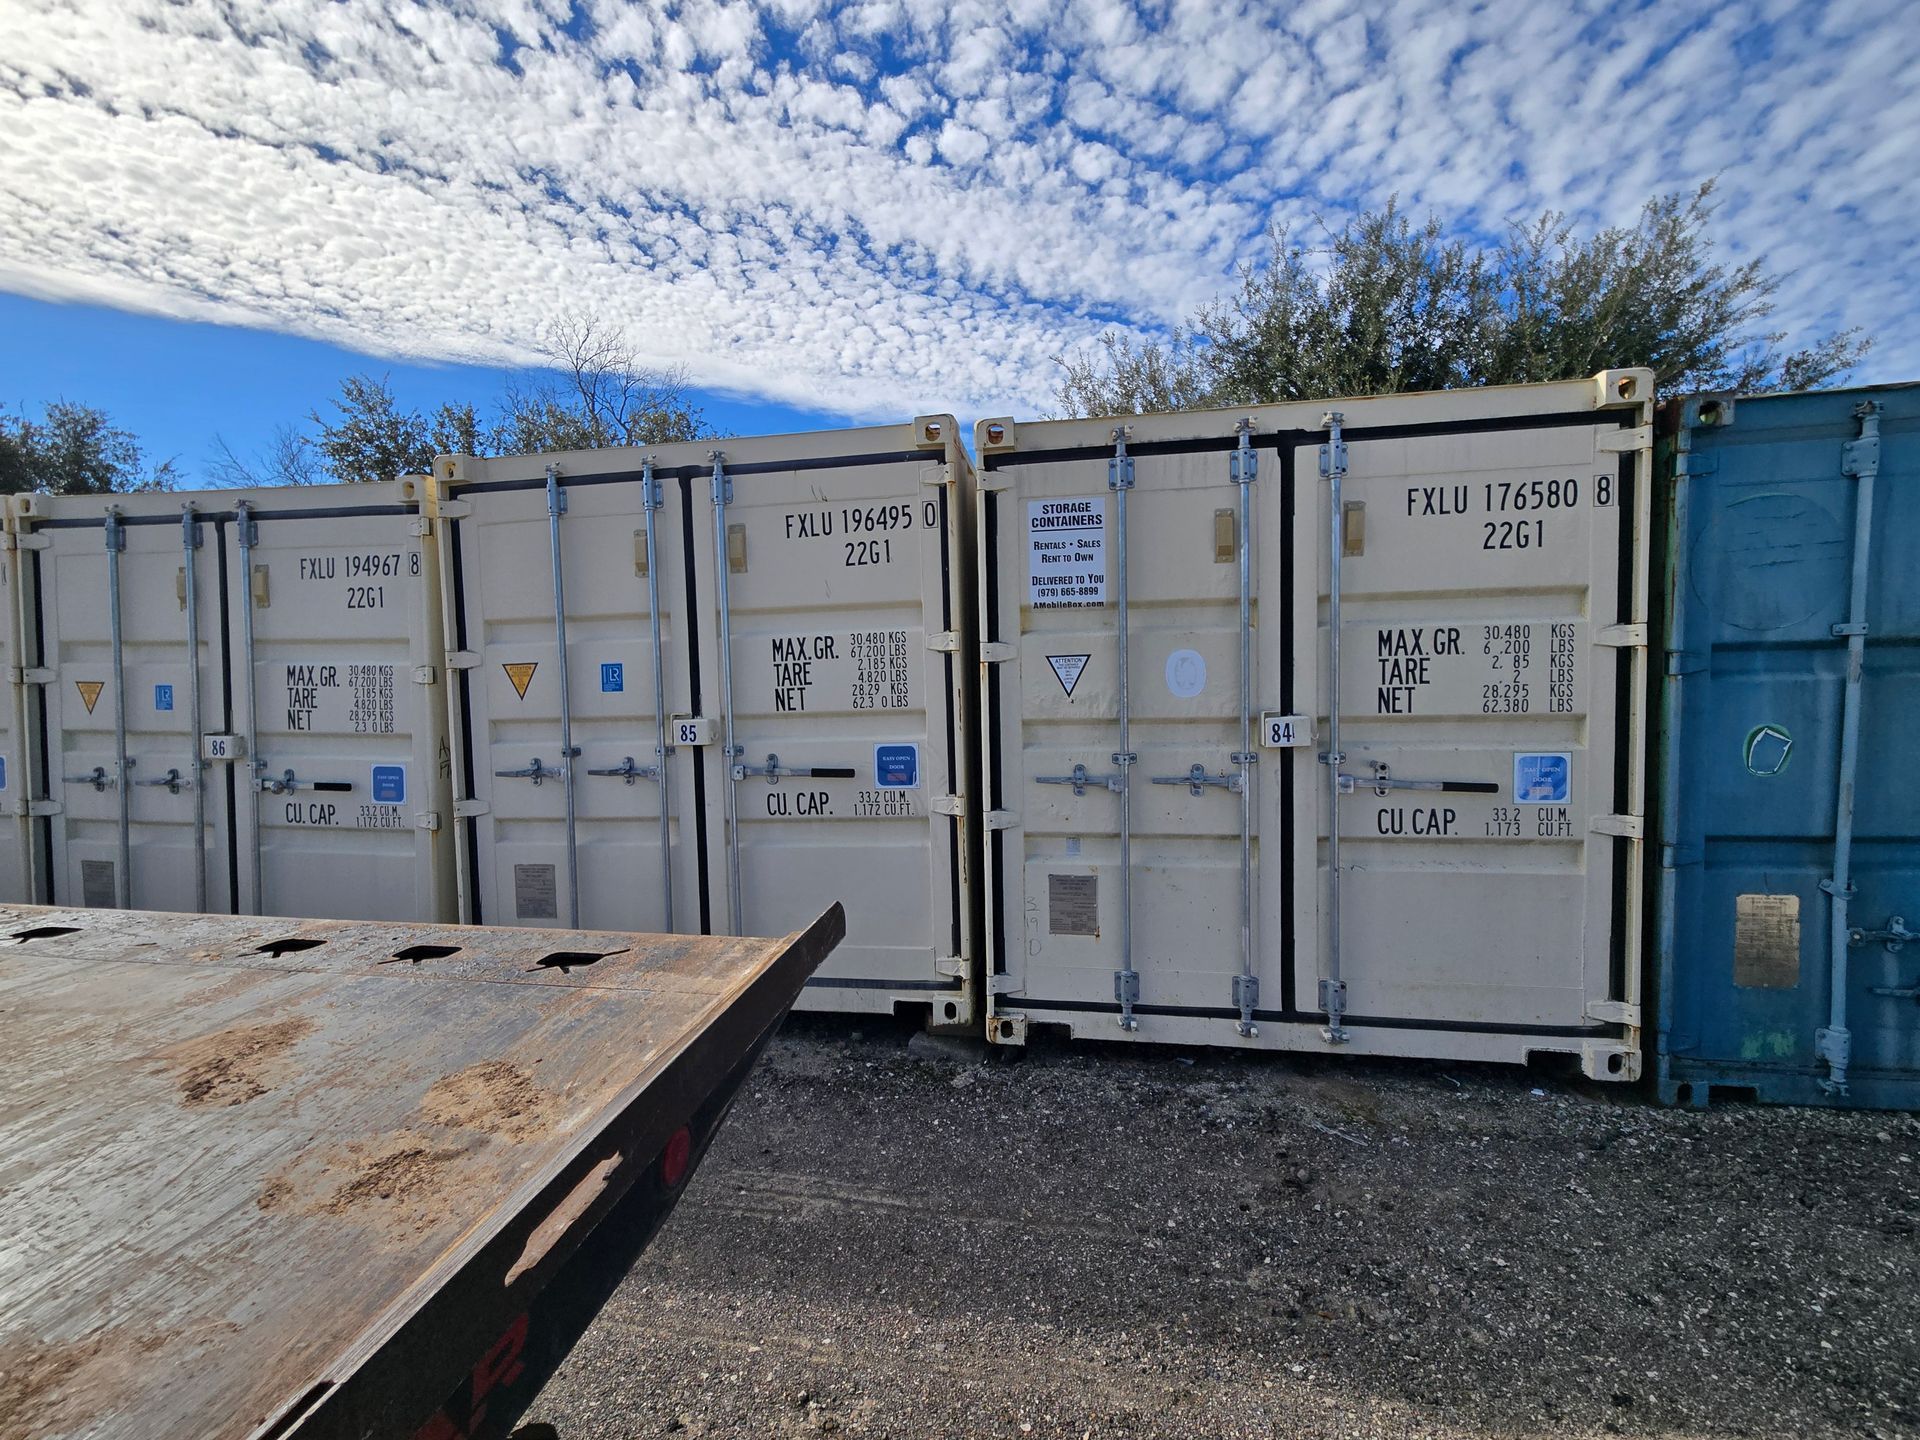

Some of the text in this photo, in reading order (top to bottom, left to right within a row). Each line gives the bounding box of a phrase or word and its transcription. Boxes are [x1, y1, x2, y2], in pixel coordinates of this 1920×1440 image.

[1407, 475, 1612, 516] FXLU 176580 8
[1042, 502, 1091, 515] STORAGE
[785, 511, 832, 539] FXLU
[842, 504, 912, 533] 196495
[1031, 514, 1102, 528] CONTAINERS
[1483, 520, 1543, 550] 22G1
[845, 539, 890, 567] 22G1
[300, 557, 335, 579] FXLU
[345, 554, 400, 577] 194967
[347, 586, 384, 608] 22G1
[1037, 587, 1099, 598] (979) 665-8899
[1033, 601, 1104, 609] AMobileBox.com
[850, 631, 906, 645] 30.480 KGS
[1484, 624, 1575, 640] 30.480 KGS
[850, 644, 906, 658] 67.200 LBS
[1551, 639, 1575, 653] LBS
[858, 657, 908, 671] 2.185 KGS
[1550, 654, 1575, 668] KGS
[348, 665, 394, 676] 30.480 KGS
[774, 662, 812, 687] TARE
[858, 669, 908, 683] 4.820 LBS
[1378, 658, 1431, 685] TARE
[1550, 669, 1574, 683] LBS
[348, 677, 393, 688] 67.200 LBS
[890, 682, 909, 695] KGS
[287, 687, 318, 709] TARE
[354, 688, 394, 699] 2.185 KGS
[1483, 684, 1574, 699] 28.295 KGS
[354, 699, 394, 710] 4.820 LBS
[775, 687, 806, 712] NET
[891, 695, 909, 708] LBS
[1378, 687, 1416, 714] NET
[1482, 698, 1574, 714] 62.380 LBS
[287, 709, 313, 731] NET
[349, 710, 394, 722] 28.295 KGS
[379, 722, 394, 733] LBS
[680, 724, 697, 742] 85
[1272, 723, 1292, 743] 84
[212, 740, 225, 756] 86
[859, 791, 880, 803] 33.2
[360, 806, 378, 817] 33.2
[854, 804, 881, 816] 1.172
[1493, 808, 1521, 822] 33.2
[357, 817, 378, 828] 1.172
[1485, 822, 1521, 837] 1.173
